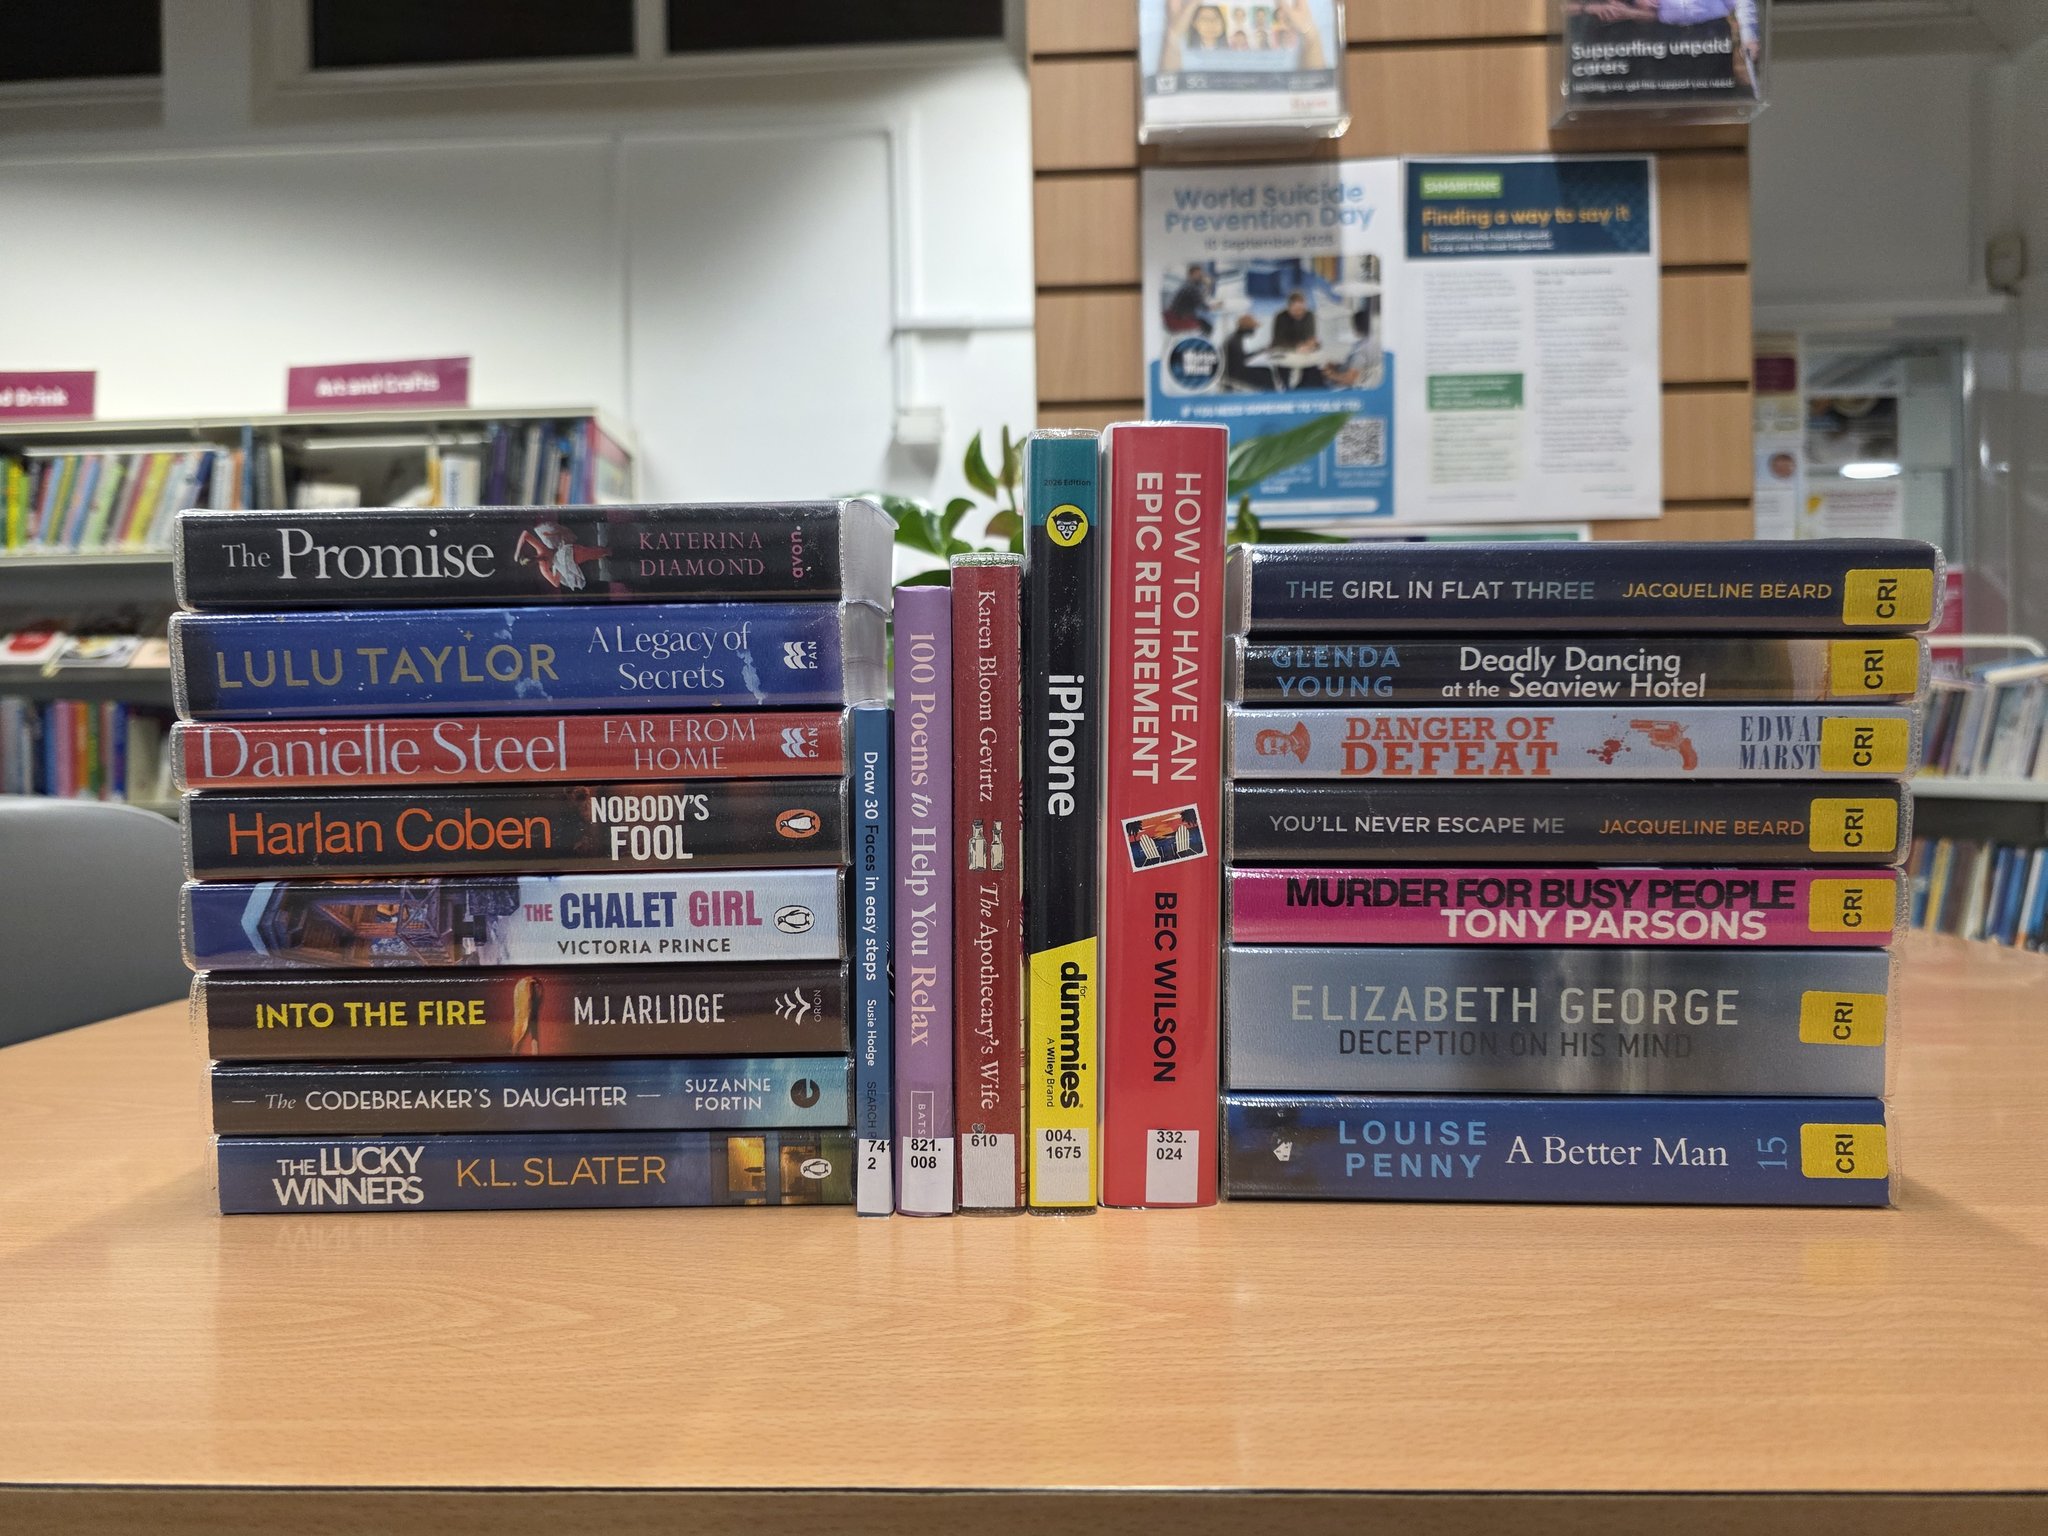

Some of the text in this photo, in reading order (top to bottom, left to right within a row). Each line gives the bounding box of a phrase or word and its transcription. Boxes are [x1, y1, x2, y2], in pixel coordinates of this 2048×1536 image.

[1572, 38, 1731, 59] Supporting unpaid
[1573, 60, 1629, 76] carers
[1174, 183, 1363, 209] World Suicide
[1165, 206, 1375, 232] Prevention Day
[1422, 205, 1630, 228] Finding a way to say it
[222, 528, 496, 579] The Promise
[640, 532, 762, 550] KATERINA
[640, 558, 765, 577] DIAMOND
[1286, 581, 1595, 600] THE GIRL IN FLAT THREE
[1622, 583, 1832, 599] JACQUELINE BEARD
[1876, 579, 1897, 618] CRI
[588, 621, 751, 659] A Legacy of
[1132, 472, 1163, 784] EPIC RETIREMENT
[1171, 473, 1201, 781] HOW TO HAVE AN
[216, 643, 559, 688] LULU TAYLOR
[809, 641, 817, 669] PAN
[1272, 646, 1400, 668] GLENDA
[1460, 647, 1681, 678] Deadly Dancing
[1864, 649, 1883, 689] CRI
[620, 663, 724, 691] Secrets
[1277, 676, 1393, 697] YOUNG
[1442, 673, 1706, 698] at the Seaview Hotel
[979, 591, 997, 802] Karen Bloom Gevirtz
[603, 719, 755, 743] FAR FROM
[809, 727, 818, 758] PAN
[1346, 717, 1555, 740] DANGER OF
[1740, 716, 1832, 741] EDWA
[203, 720, 567, 778] Danielle Steel
[634, 748, 727, 771] HOME
[1048, 675, 1084, 816] iPhone
[1340, 742, 1558, 776] DEFEAT
[1739, 745, 1821, 770] MARST
[1853, 728, 1873, 766] CRI
[591, 795, 709, 823] NOBODY'S
[229, 808, 551, 855] Harlan Coben
[1270, 816, 1565, 833] YOU'LL NEVER ESCAPE ME
[1599, 820, 1804, 835] JACQUELINE BEARD
[1844, 808, 1863, 847] CRI
[611, 825, 692, 861] FOOL
[905, 633, 936, 1046] 100 Poems to Help You Relax
[863, 752, 879, 981] Draw 30 Faces in easy steps
[1287, 878, 1795, 909] MURDER FOR BUSY PEOPLE
[524, 890, 762, 929] THE CHALET GIRL
[1844, 889, 1863, 927] CRI
[1441, 910, 1766, 940] TONY PARSONS
[558, 938, 731, 954] VICTORIA PRINCE
[974, 883, 999, 1109] The Apothecary's Wife
[1153, 892, 1177, 1082] BEC WILSON
[255, 1000, 486, 1028] INTO THE FIRE
[622, 994, 724, 1024] ARLIDGE
[814, 990, 822, 1022] ORION
[1292, 986, 1739, 1025] ELIZABETH GEORGE
[866, 1000, 876, 1066] Susie Hodge
[1060, 962, 1087, 1108] dummies
[1833, 1002, 1853, 1040] CRI
[1340, 1030, 1691, 1058] DECEPTION ON HIS MIND
[1045, 1047, 1055, 1075] Wiley
[266, 1087, 627, 1111] The CODEBREAKER'S DAUGHTER
[685, 1078, 771, 1093] SUZANNE
[1047, 1079, 1055, 1107] Brand
[695, 1097, 762, 1111] FORTIN
[867, 1082, 876, 1128] SEARCH
[918, 1103, 926, 1139] BATS
[1340, 1120, 1486, 1145] LOUISE
[911, 1139, 941, 1151] 821.
[972, 1135, 997, 1147] 610
[1046, 1130, 1076, 1142] 004.
[1157, 1131, 1187, 1143] 332.
[277, 1146, 424, 1175] THE LUCKY
[868, 1158, 876, 1169] 2
[911, 1156, 936, 1168] 008
[1046, 1147, 1081, 1159] 1675
[1157, 1148, 1183, 1160] 024
[1506, 1136, 1728, 1166] A Better Man
[1757, 1137, 1787, 1170] 15
[1836, 1134, 1854, 1173] CRI
[524, 1156, 666, 1186] SLATER
[1347, 1154, 1481, 1178] PENNY
[273, 1176, 424, 1206] WINNERS
